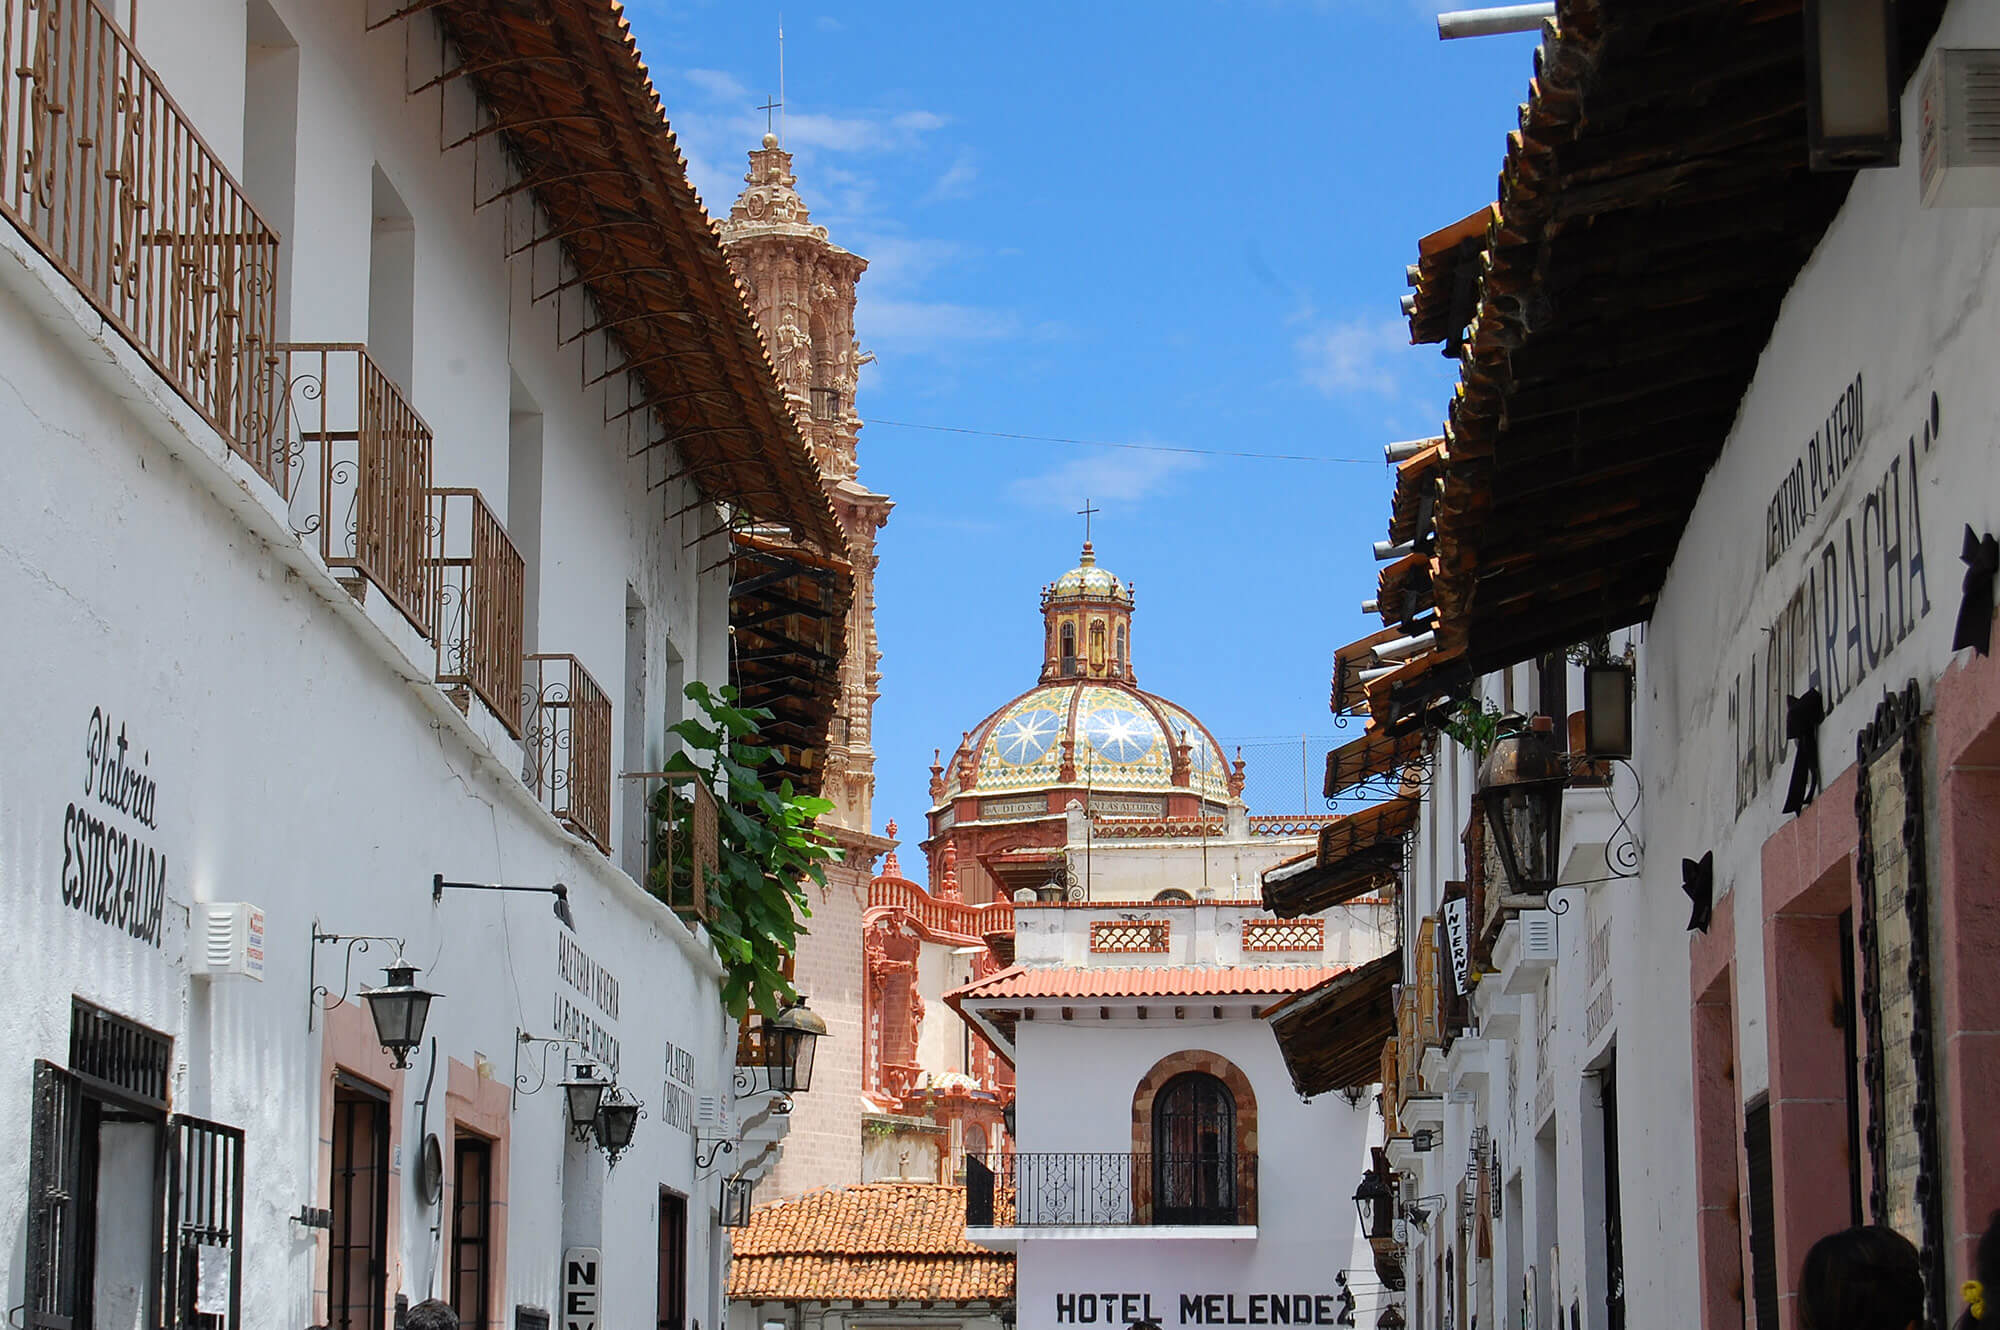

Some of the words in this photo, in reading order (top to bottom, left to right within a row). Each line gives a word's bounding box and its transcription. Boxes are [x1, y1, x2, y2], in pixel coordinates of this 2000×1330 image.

[1765, 456, 1807, 574] CENTRO
[1808, 372, 1864, 513] PLATERO
[62, 802, 167, 949] ESMERALDA
[665, 1041, 695, 1089] PLATERIA
[1056, 1293, 1163, 1324] HOTEL
[1179, 1293, 1355, 1325] MELENDEZ
